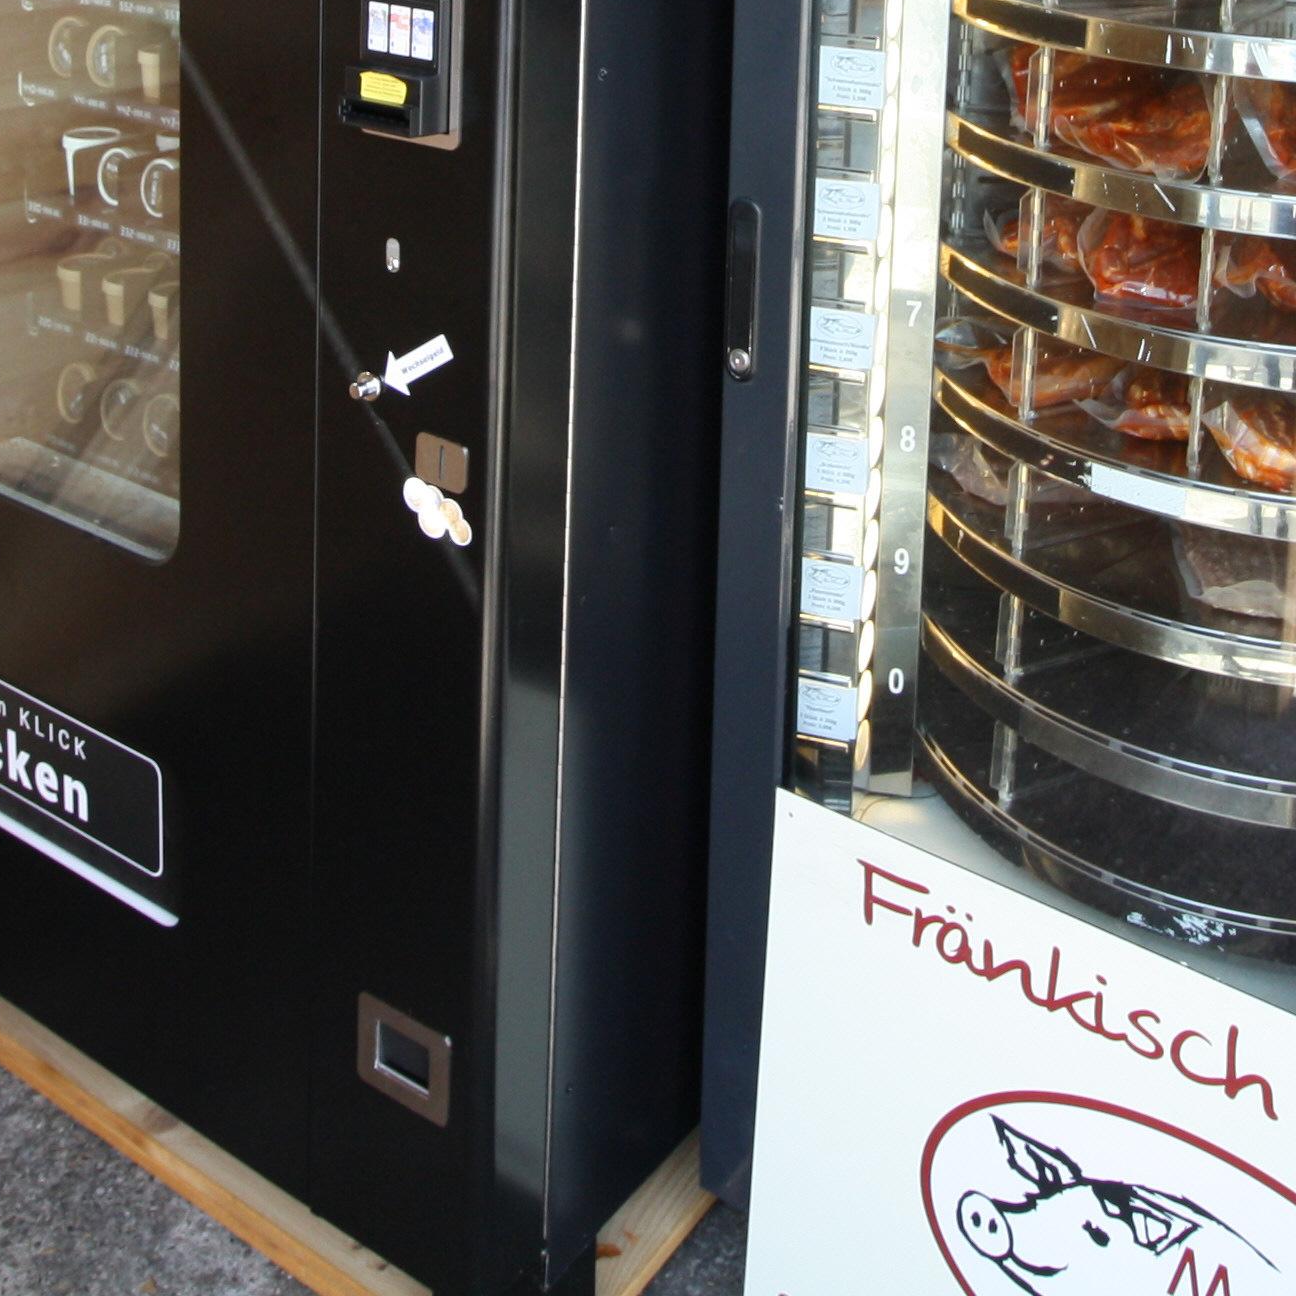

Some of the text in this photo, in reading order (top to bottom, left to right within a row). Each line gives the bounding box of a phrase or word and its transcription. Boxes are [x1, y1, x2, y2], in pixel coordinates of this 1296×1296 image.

[906, 300, 923, 327] 7
[899, 425, 916, 453] 8
[894, 548, 910, 575] 9
[888, 667, 904, 694] 0
[19, 707, 87, 761] KLICK
[857, 858, 1279, 1121] Fränkisch
